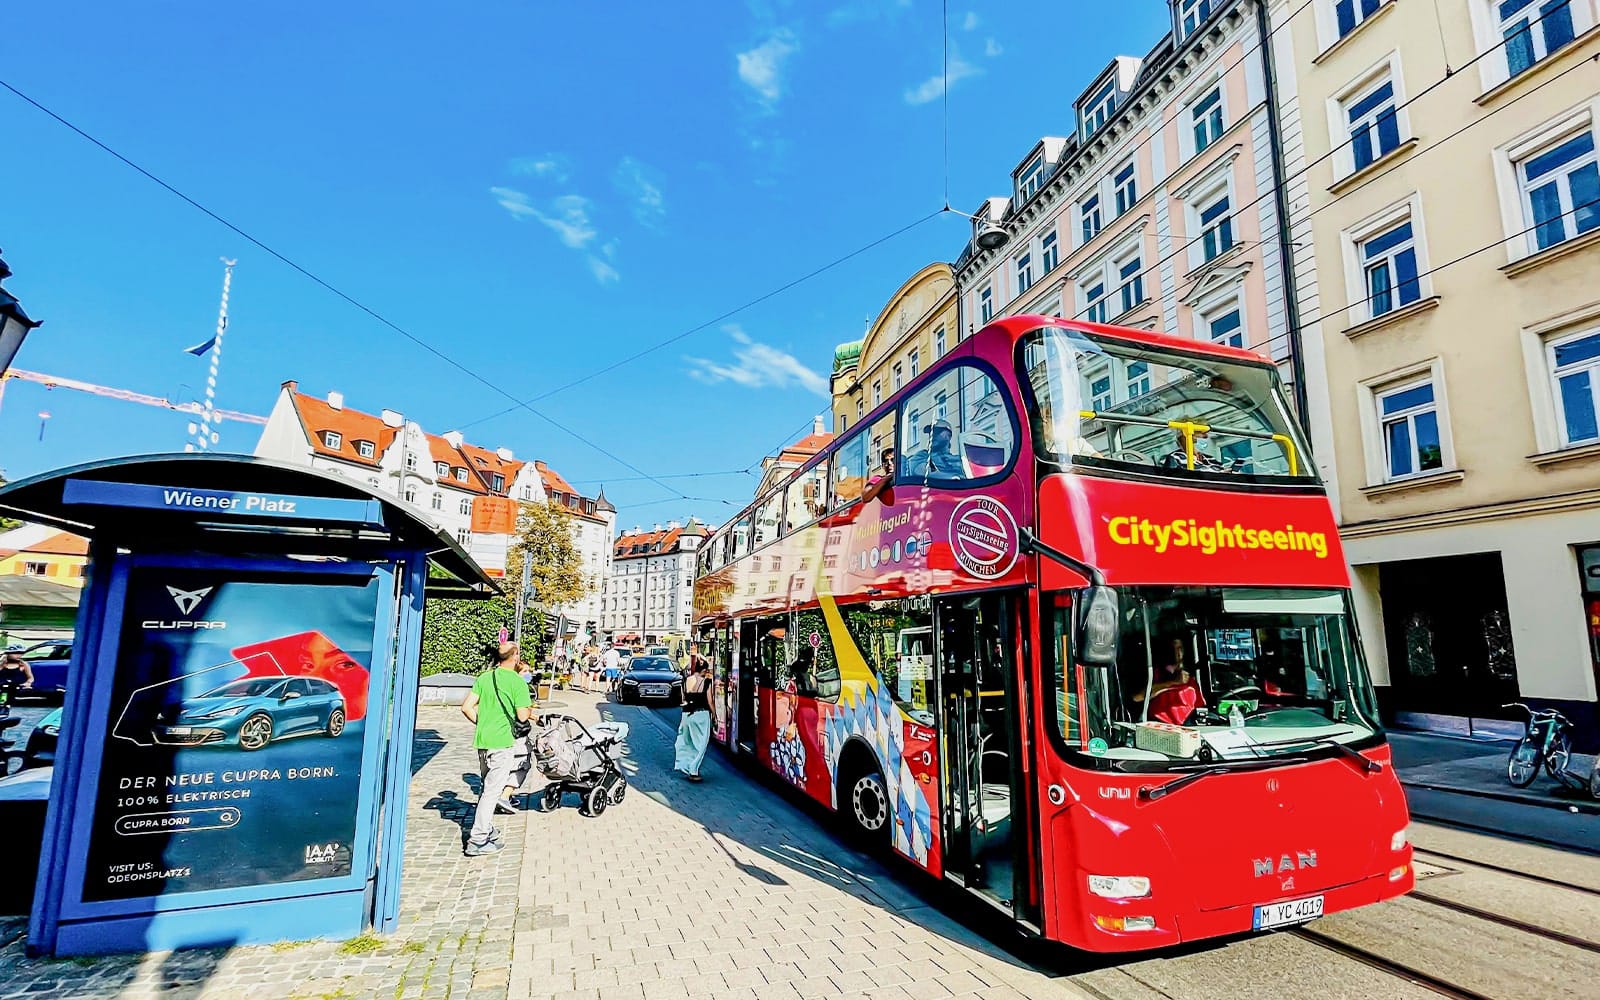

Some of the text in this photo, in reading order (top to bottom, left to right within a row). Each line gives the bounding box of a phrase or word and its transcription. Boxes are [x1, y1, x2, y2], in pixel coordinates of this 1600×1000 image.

[164, 490, 296, 512] Wiener Platz
[976, 499, 999, 515] TOUR
[956, 521, 1009, 553] CitySightseeing
[1108, 516, 1328, 558] CitySightseeing
[142, 621, 226, 629] CUPRA
[119, 766, 340, 790] DER NEUE CUPRA BORN.
[117, 789, 251, 808] 100% ELEKTRISCH
[123, 817, 190, 830] CUPRA BORN
[109, 862, 154, 873] VISIT US:
[1252, 849, 1317, 878] MAN
[107, 868, 184, 884] ODEONSPLATZ
[1262, 898, 1323, 924] M YC 4019
